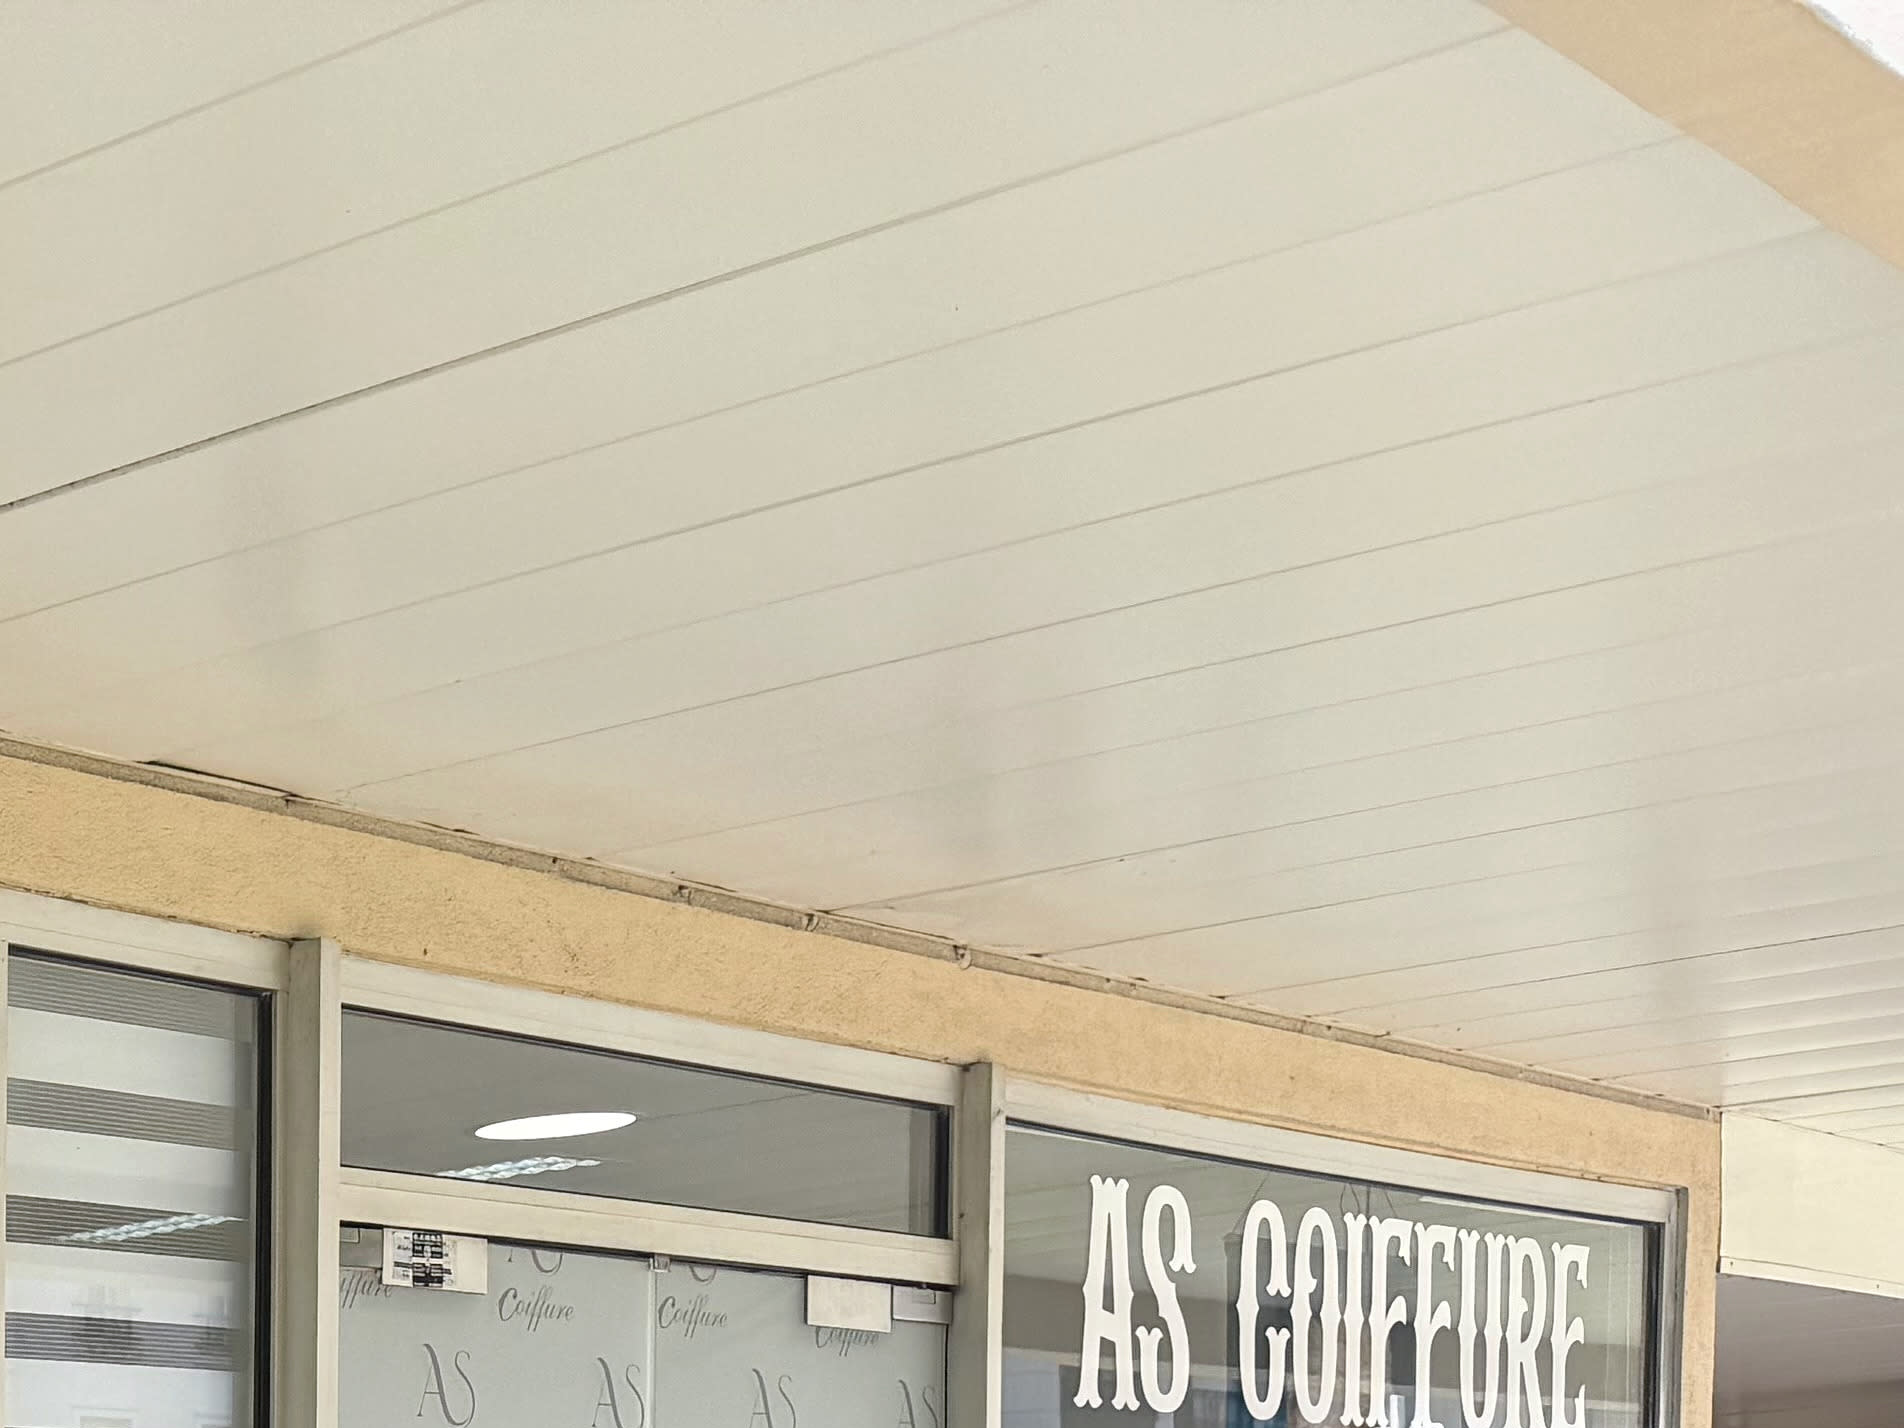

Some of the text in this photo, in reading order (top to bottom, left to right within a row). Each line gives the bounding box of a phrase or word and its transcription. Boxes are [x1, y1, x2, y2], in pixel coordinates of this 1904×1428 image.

[498, 1284, 575, 1332] Coiffure
[1073, 1175, 1197, 1414] AS
[416, 1343, 476, 1428] AS
